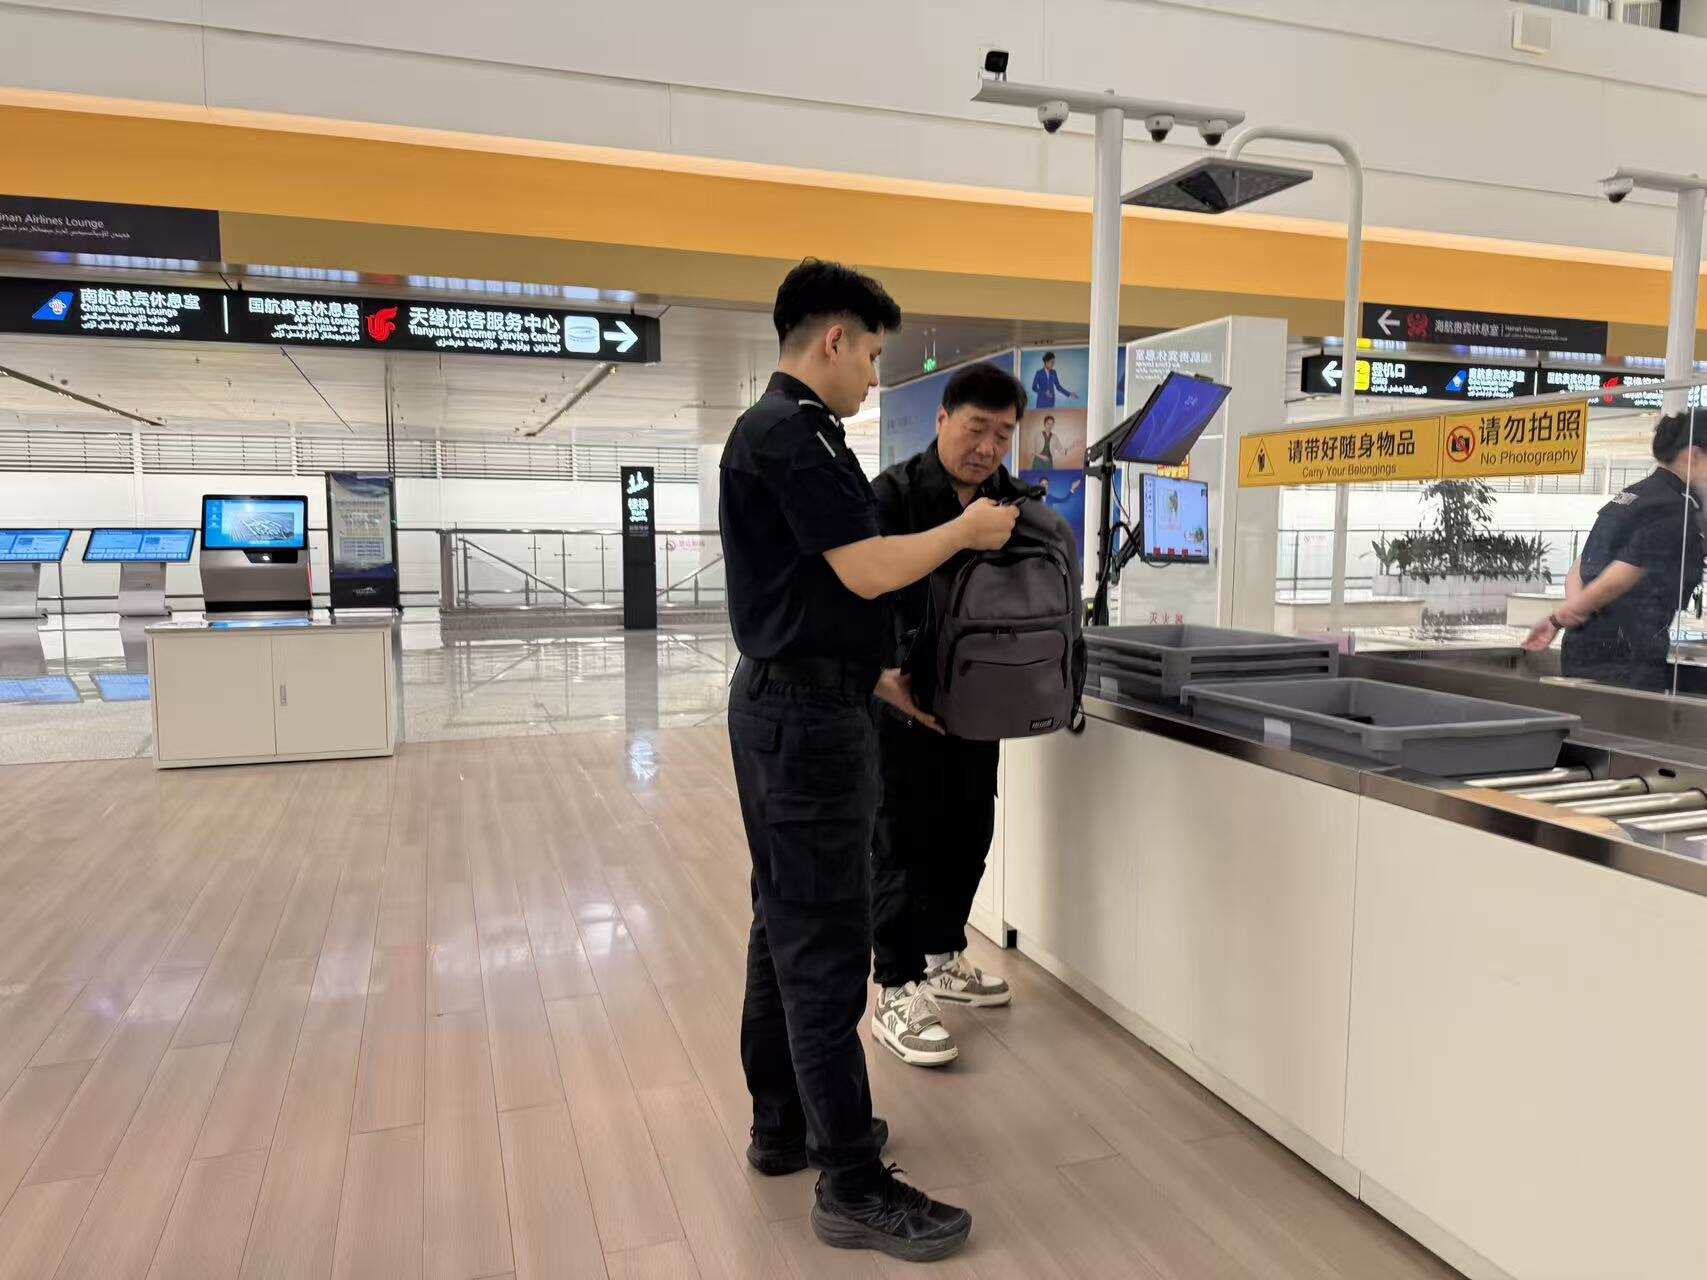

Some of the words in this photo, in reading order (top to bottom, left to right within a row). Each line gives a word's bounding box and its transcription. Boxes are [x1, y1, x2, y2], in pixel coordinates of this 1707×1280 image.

[25, 214, 63, 226] Airlines
[65, 216, 104, 230] Lounge
[80, 288, 201, 310] 南航贵宾休息室
[248, 297, 360, 319] 国航贵宾休息室
[409, 307, 560, 333] 天缘旅客服务中心
[408, 324, 452, 338] Tianyuan
[453, 328, 496, 340] Customer
[497, 331, 530, 341] Service
[531, 332, 561, 344] Center
[1479, 409, 1581, 446] 请勿拍照
[1288, 429, 1416, 464] 请带好随身物品
[1481, 453, 1497, 465] No
[1500, 447, 1579, 466] Photography
[1302, 466, 1324, 480] Carry
[1326, 464, 1346, 478] Your
[1347, 463, 1397, 478] Belongings
